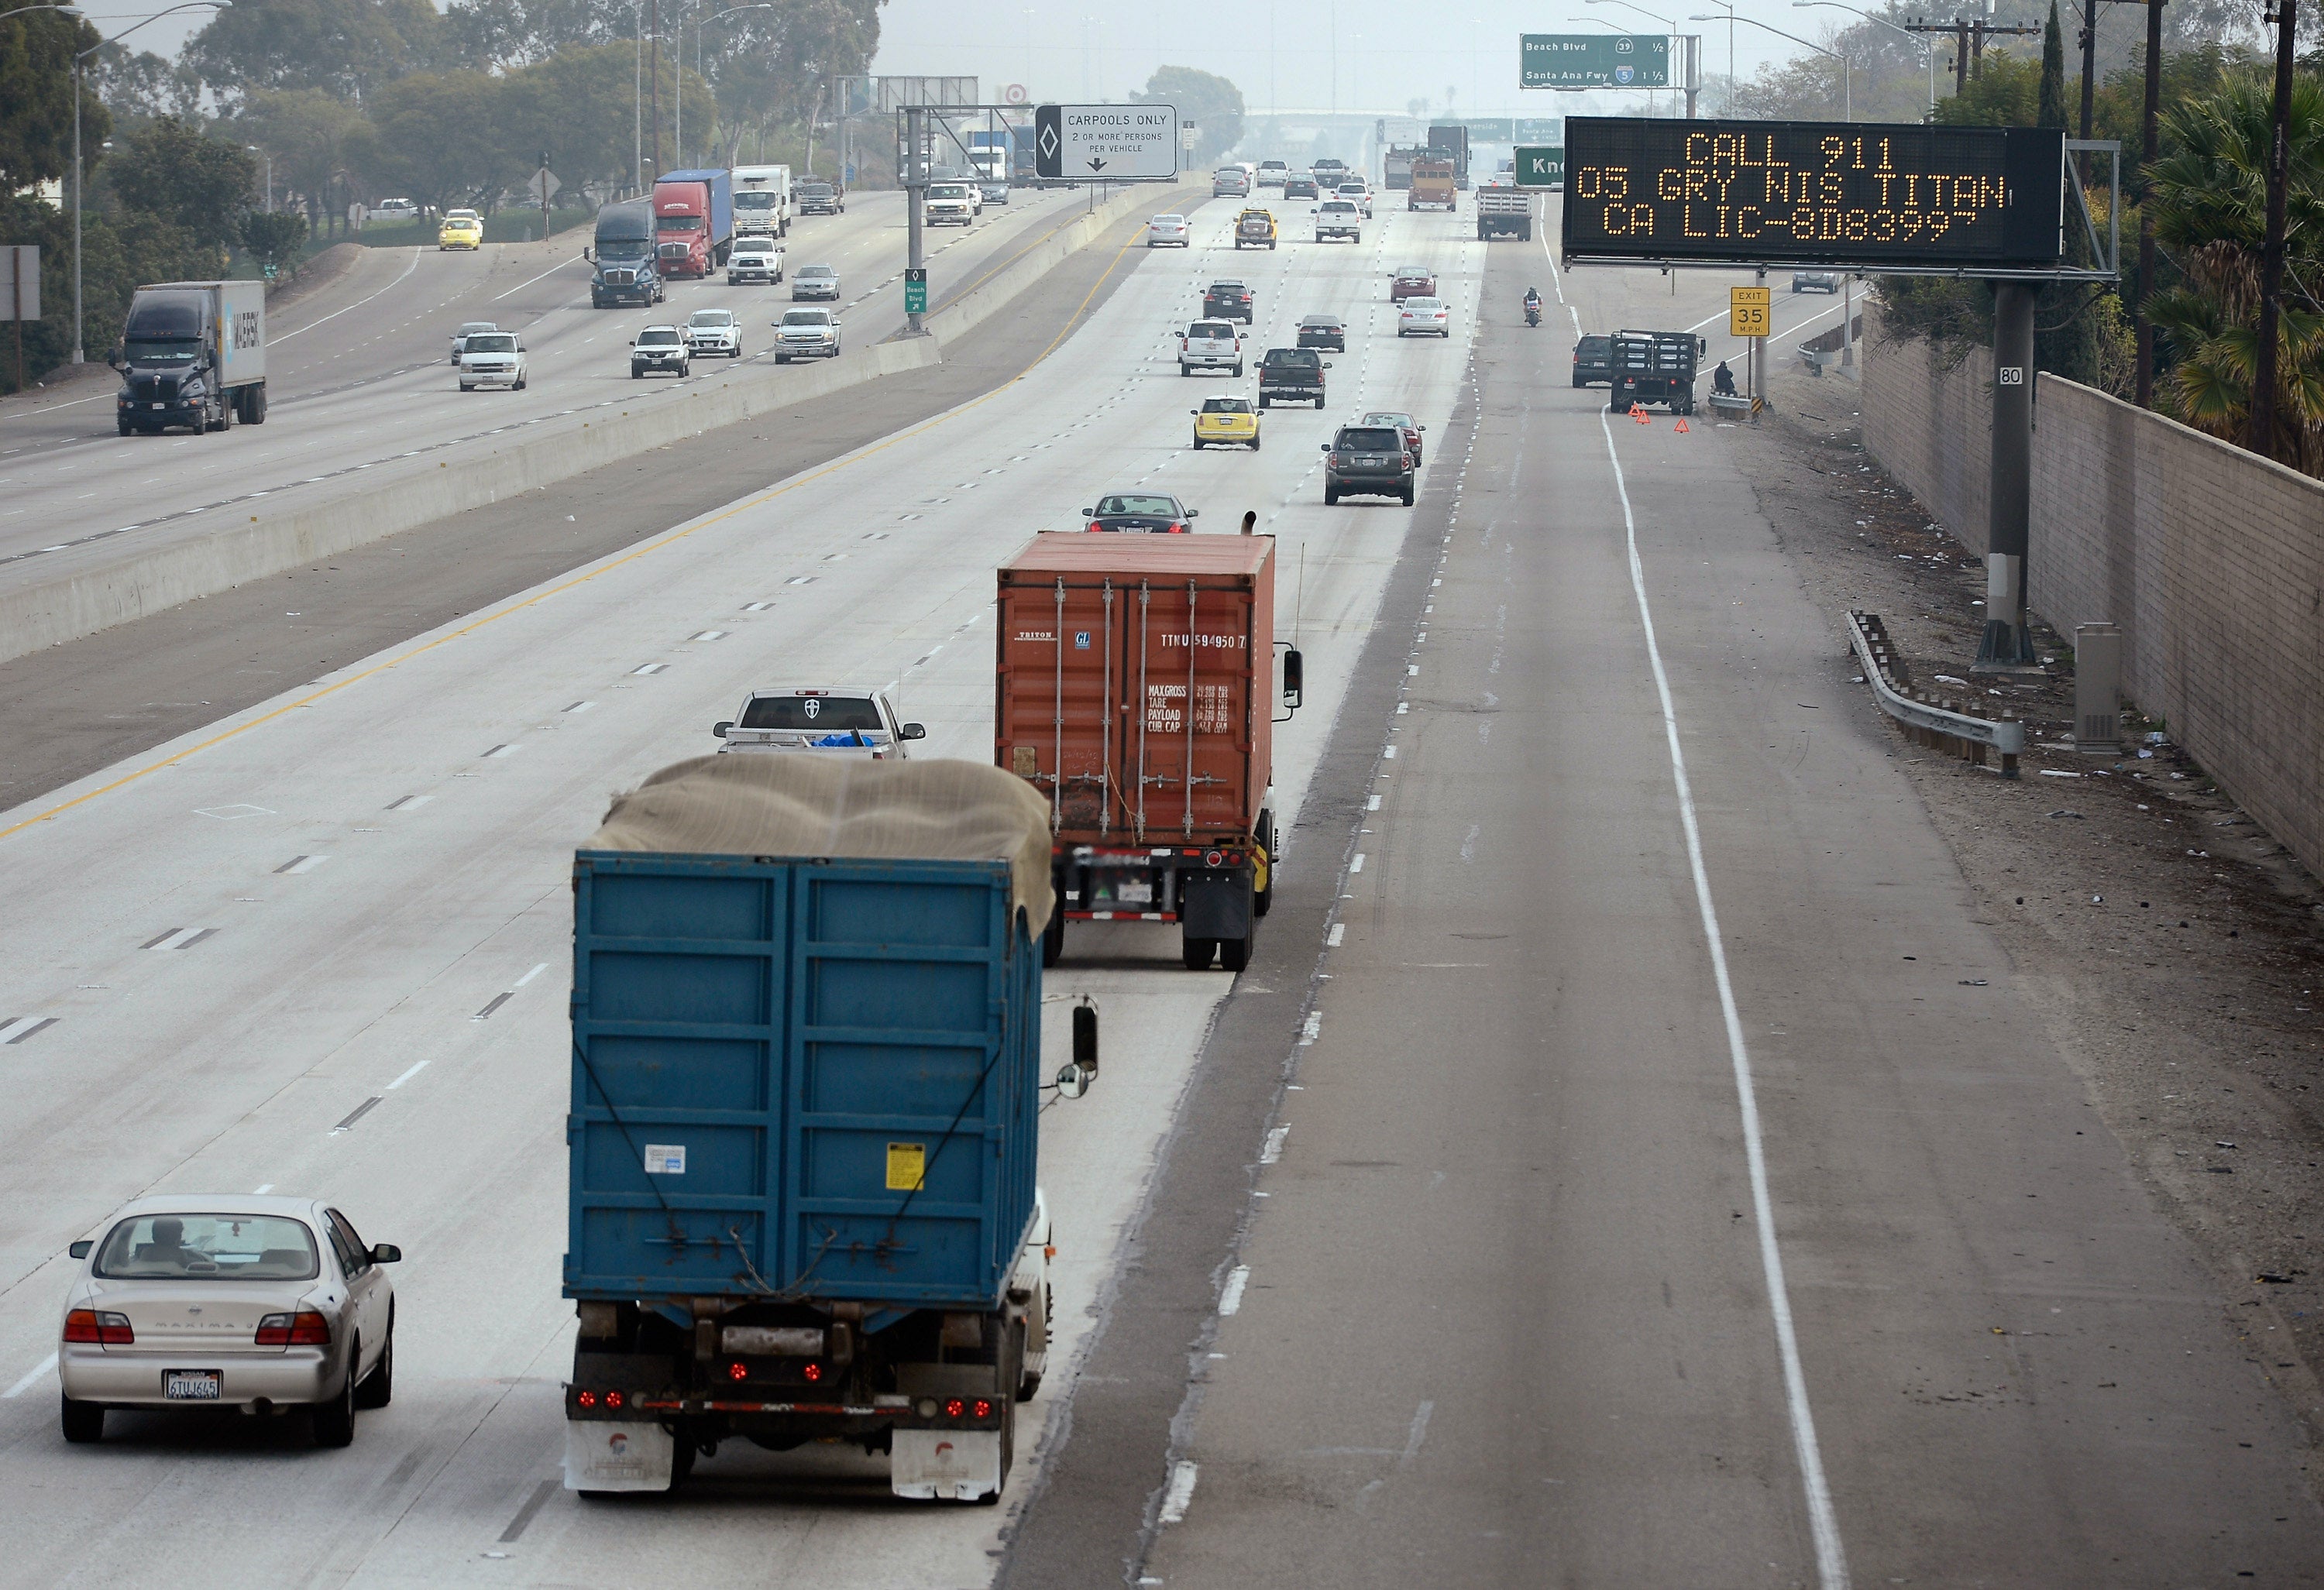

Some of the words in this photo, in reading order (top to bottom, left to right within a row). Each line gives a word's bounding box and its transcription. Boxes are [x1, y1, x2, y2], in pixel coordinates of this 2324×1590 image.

[1526, 43, 1558, 51] Beach
[1563, 43, 1587, 51] Blvd
[1587, 71, 1608, 81] Fwy
[1068, 115, 1130, 125] CARPOOLS
[1137, 115, 1167, 125] ONLY
[1072, 132, 1078, 141] 2
[1686, 132, 1789, 167] CALL
[1820, 136, 1893, 170] 911
[1577, 167, 1628, 199] 05
[1658, 168, 1735, 201] GRY
[1765, 170, 1843, 204] NIS
[1873, 173, 2004, 208] TITAN
[1604, 203, 1654, 235] CA
[1738, 308, 1762, 323] 35
[234, 311, 260, 349] MAERSK
[2002, 369, 2020, 383] 80
[1075, 632, 1089, 644] GL
[1161, 634, 1189, 647] TTNU
[1194, 634, 1235, 648] 594950
[1239, 635, 1246, 648] 7
[1149, 697, 1167, 709] TARE
[1148, 709, 1181, 721] PAYLOAD
[1147, 721, 1164, 732] CUB.
[1165, 722, 1181, 733] CAP.
[170, 1381, 216, 1394] 6TUJ645
